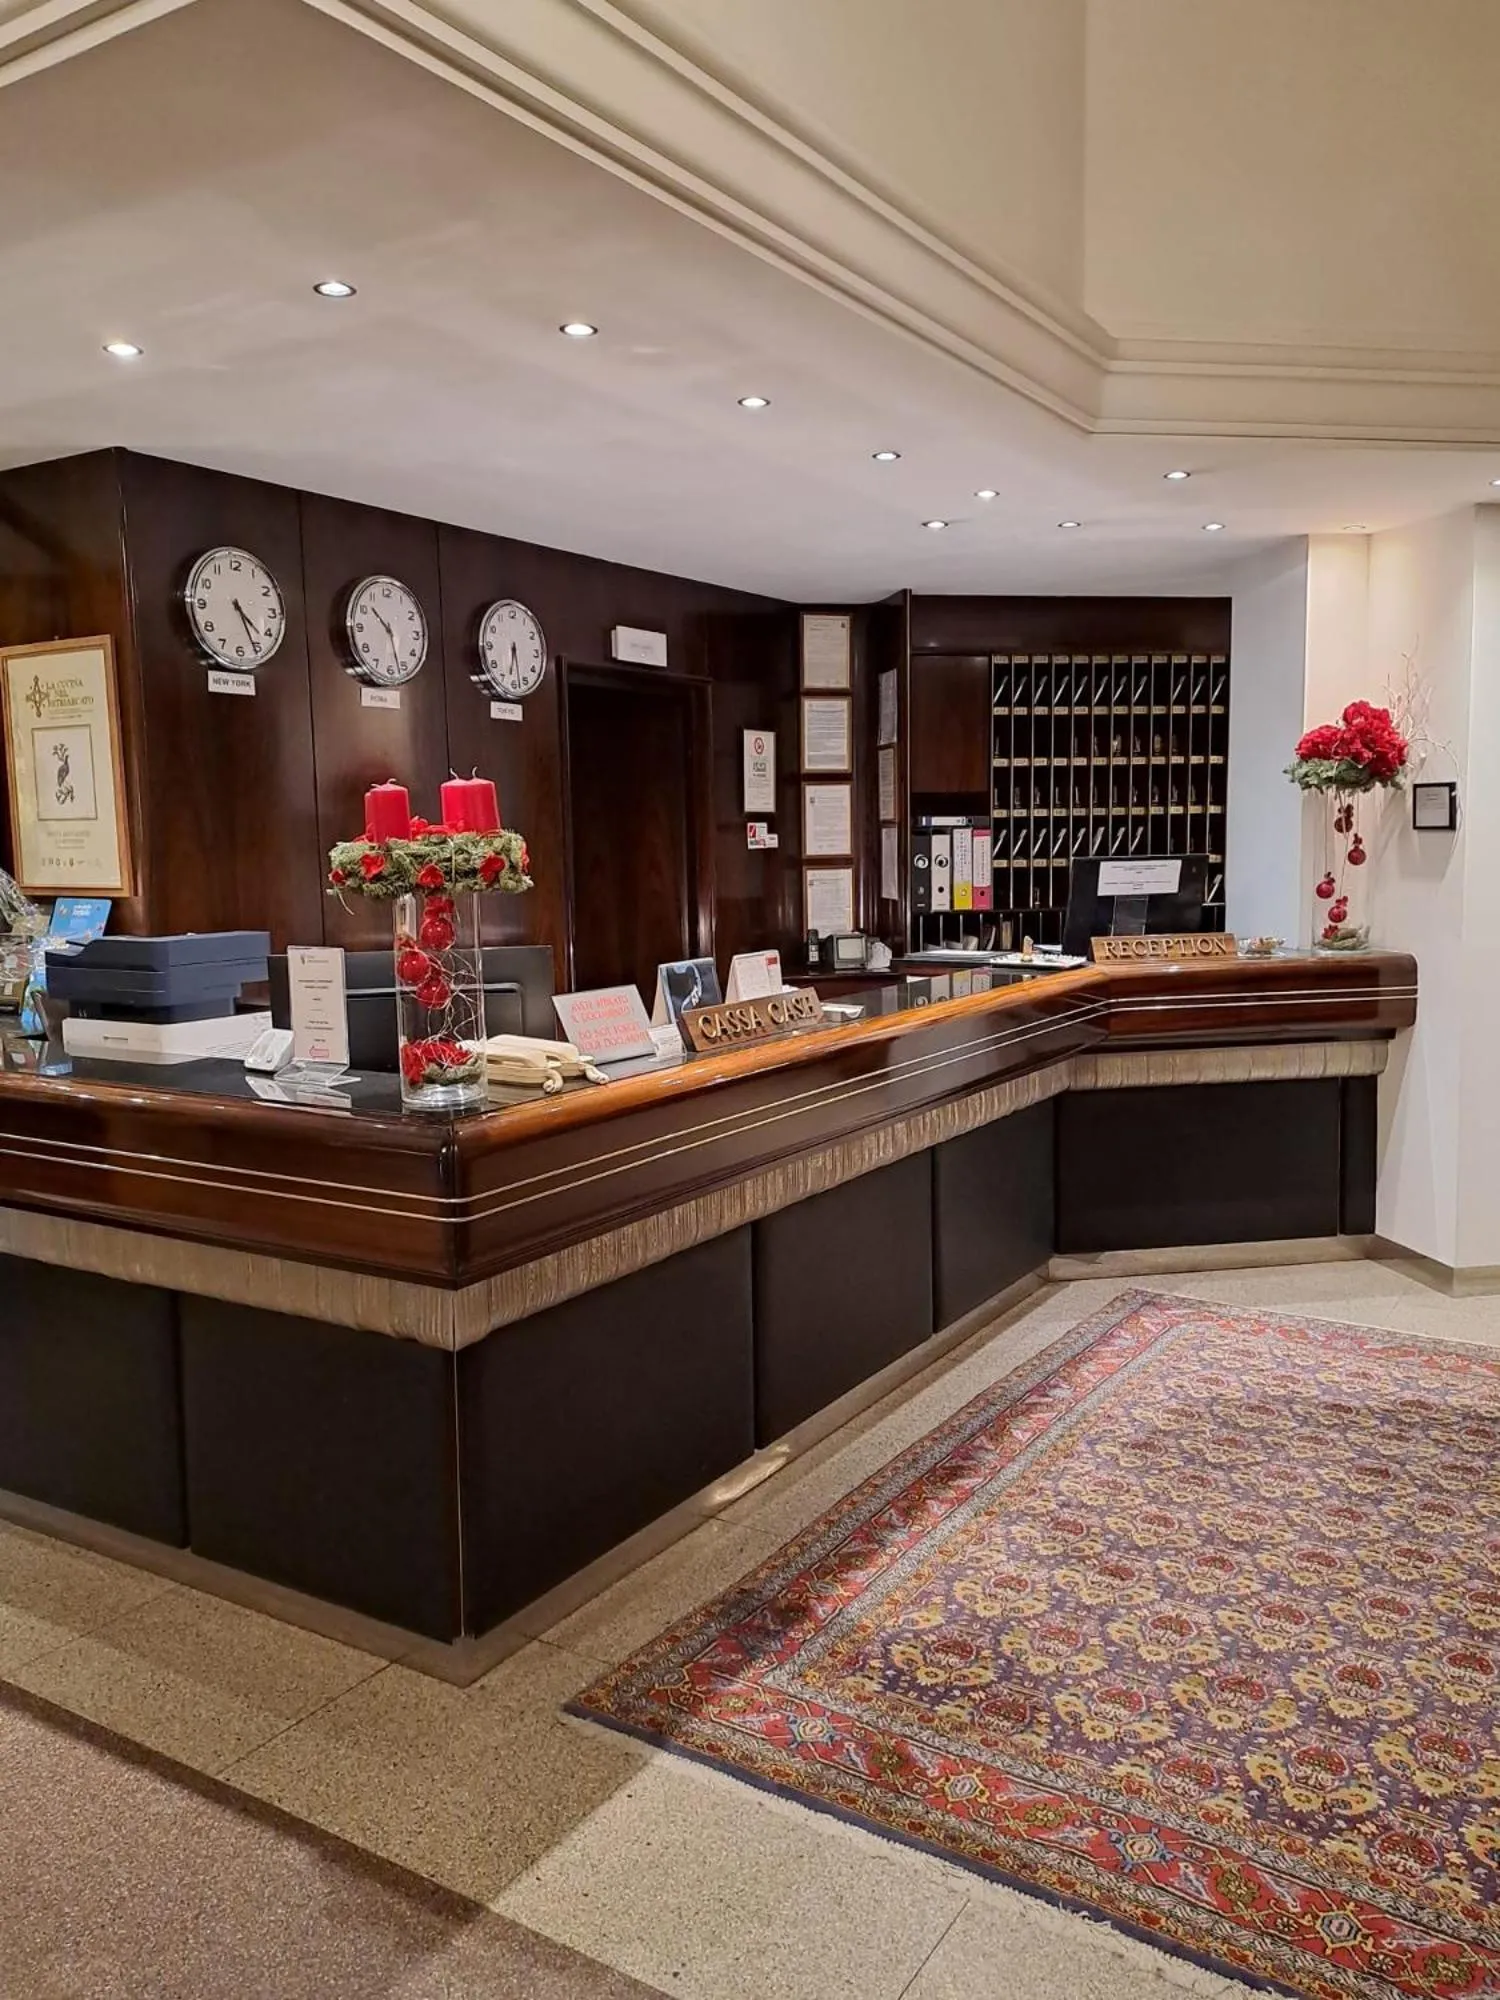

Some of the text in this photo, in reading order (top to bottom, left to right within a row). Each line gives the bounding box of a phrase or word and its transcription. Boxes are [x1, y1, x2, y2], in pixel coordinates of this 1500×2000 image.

[214, 563, 221, 576] 11
[229, 559, 242, 572] 12
[201, 577, 211, 589] 10
[261, 586, 271, 597] 2
[370, 591, 376, 603] 11
[382, 588, 392, 598] 12
[197, 598, 207, 609] 9
[267, 608, 277, 619] 3
[359, 605, 368, 615] 10
[407, 611, 416, 621] 2
[204, 620, 214, 632] 8
[356, 623, 364, 633] 9
[264, 628, 273, 638] 4
[412, 631, 420, 641] 3
[218, 638, 227, 650] 7
[361, 643, 370, 653] 8
[235, 646, 245, 657] 6
[409, 648, 417, 657] 4
[372, 659, 380, 669] 7
[400, 661, 408, 671] 5
[386, 665, 395, 675] 6
[212, 677, 250, 688] NEW YORK
[1103, 936, 1227, 959] RECEPTION
[698, 996, 815, 1039] CASSA CASH
